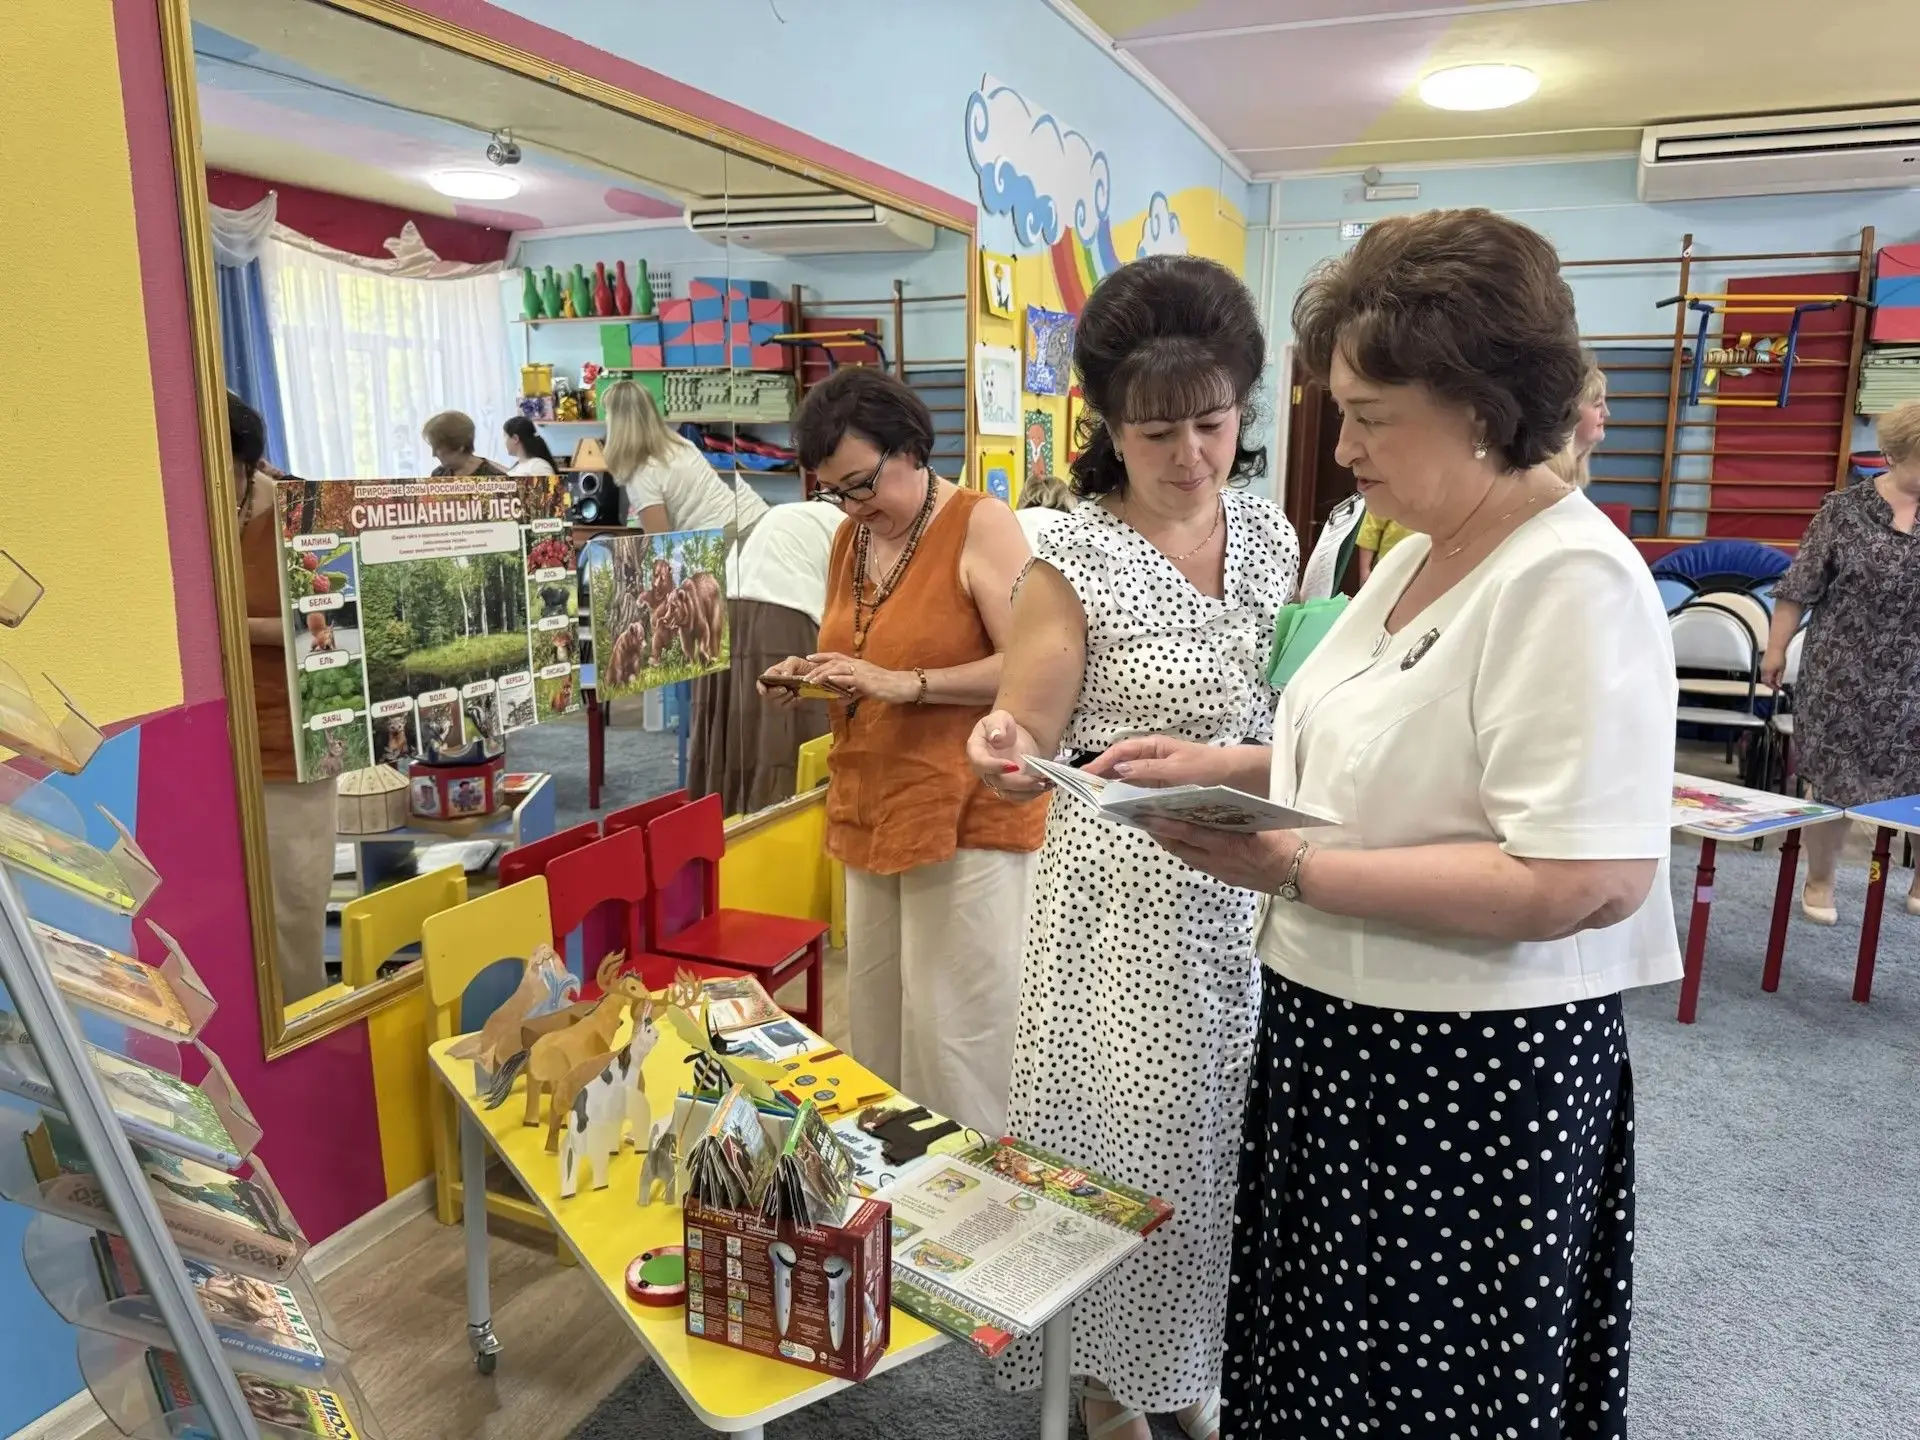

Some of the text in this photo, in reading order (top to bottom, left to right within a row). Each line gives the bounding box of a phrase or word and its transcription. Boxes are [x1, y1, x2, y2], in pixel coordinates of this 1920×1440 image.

[356, 482, 516, 498] ПРИРОДНЫЕ ЗОНЫ РОССИЙСКОЙ ФЕДЕРАЦИИ
[351, 495, 522, 529] СМЕШАННЫЙ ЛЕС
[301, 537, 332, 547] МАЛИНА
[308, 597, 333, 607] БЕЛКА
[319, 656, 335, 666] ЕЛЬ
[429, 692, 447, 703] ВОЛК
[380, 702, 406, 713] КУНИЦА
[322, 713, 342, 725] ЗАЯЦ
